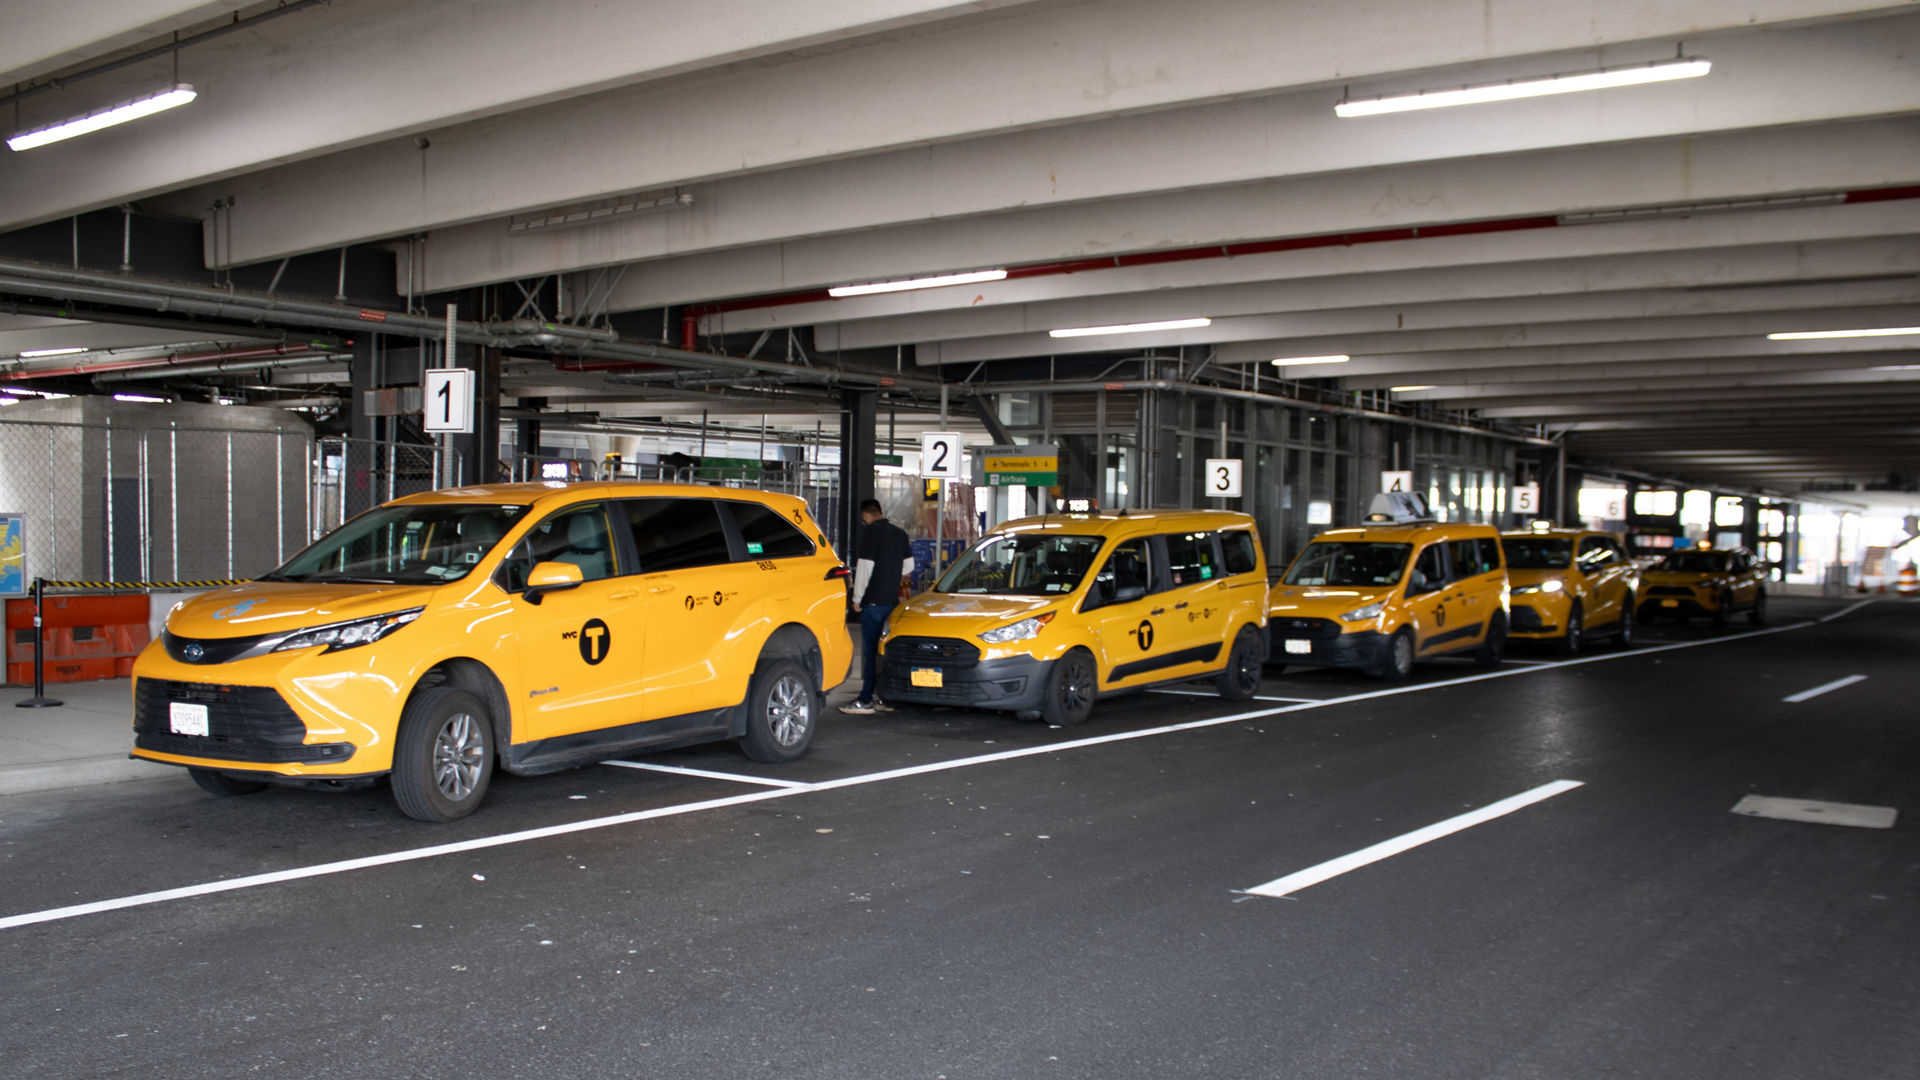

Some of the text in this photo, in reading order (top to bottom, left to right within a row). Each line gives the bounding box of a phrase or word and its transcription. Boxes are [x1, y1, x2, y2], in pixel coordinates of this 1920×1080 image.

[438, 380, 450, 423] 1
[931, 441, 948, 472] 2
[1216, 466, 1230, 491] 3
[1390, 477, 1401, 492] 4
[1519, 492, 1531, 509] 5
[1608, 502, 1618, 515] 6
[562, 631, 578, 640] NYC
